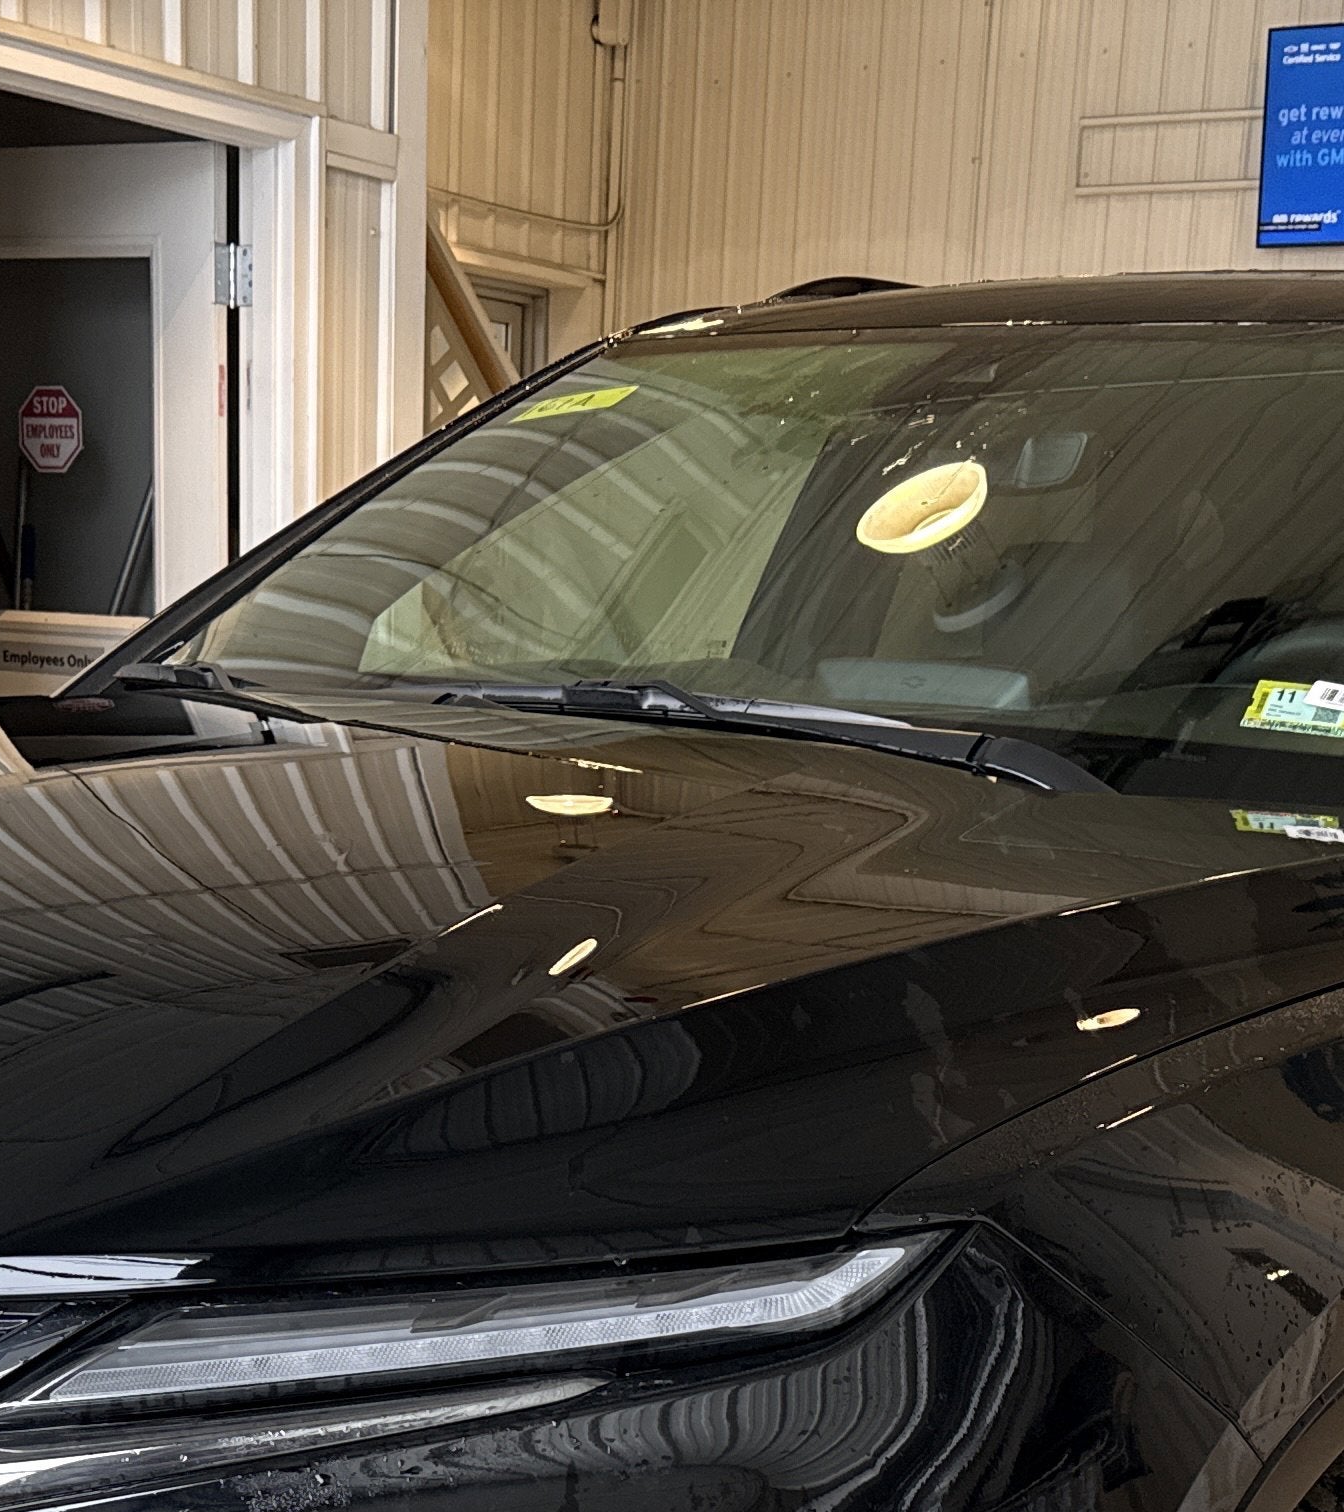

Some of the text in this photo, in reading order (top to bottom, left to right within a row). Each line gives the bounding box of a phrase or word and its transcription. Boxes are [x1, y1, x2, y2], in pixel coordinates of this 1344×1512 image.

[1278, 104, 1307, 126] get
[1291, 127, 1308, 145] at
[1276, 151, 1312, 168] with
[1317, 148, 1344, 166] GM
[32, 396, 68, 415] STOP
[26, 423, 75, 440] EMPLOYEES
[39, 443, 61, 459] ONLY
[2, 650, 65, 669] Employees
